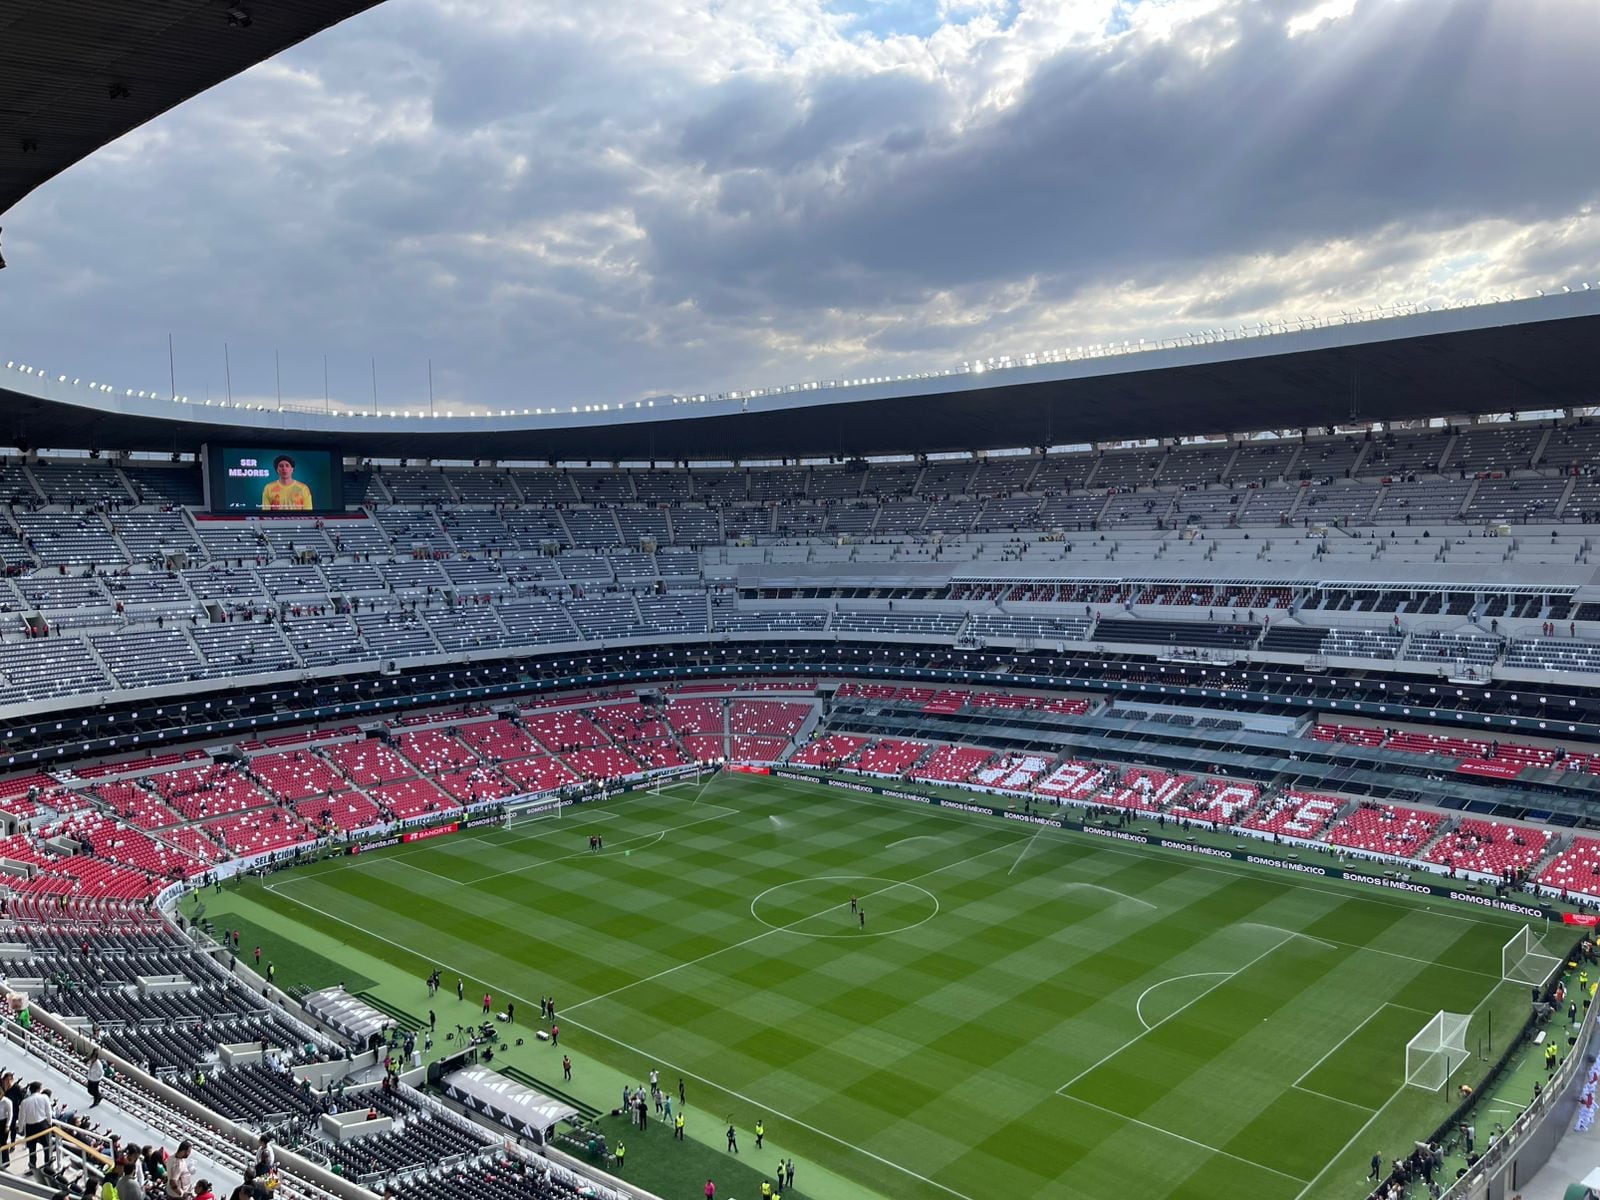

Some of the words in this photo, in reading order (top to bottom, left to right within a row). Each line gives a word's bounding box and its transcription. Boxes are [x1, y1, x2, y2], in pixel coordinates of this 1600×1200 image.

[240, 459, 257, 467] SER
[228, 469, 270, 477] MEJORES
[777, 771, 797, 780] SOMOS
[800, 775, 820, 784] MÉXICO
[828, 780, 849, 789] SOMOS
[852, 784, 873, 793] MÉXICO
[882, 789, 904, 799] SOMOS
[907, 793, 930, 804] MÉXICO
[940, 799, 964, 810] SOMOS
[968, 803, 993, 815] MÉXICO
[467, 817, 490, 828] SOMOS
[1004, 811, 1030, 822] SOMOS
[1034, 816, 1062, 828] MÉXICO
[419, 826, 452, 838] BANORTE
[1083, 825, 1112, 837] SOMOS
[1117, 830, 1148, 844] MÉXICO
[360, 837, 399, 852] caliente.mx
[1161, 839, 1192, 852] SOMOS
[1199, 844, 1232, 858] MÉXICO
[1247, 855, 1281, 868] SOMOS
[1288, 860, 1326, 876] MÉXICO
[1342, 871, 1381, 886] SOMOS
[1390, 880, 1431, 894] MÉXICO
[1450, 891, 1491, 906] SOMOS
[1500, 901, 1542, 918] MÉXICO
